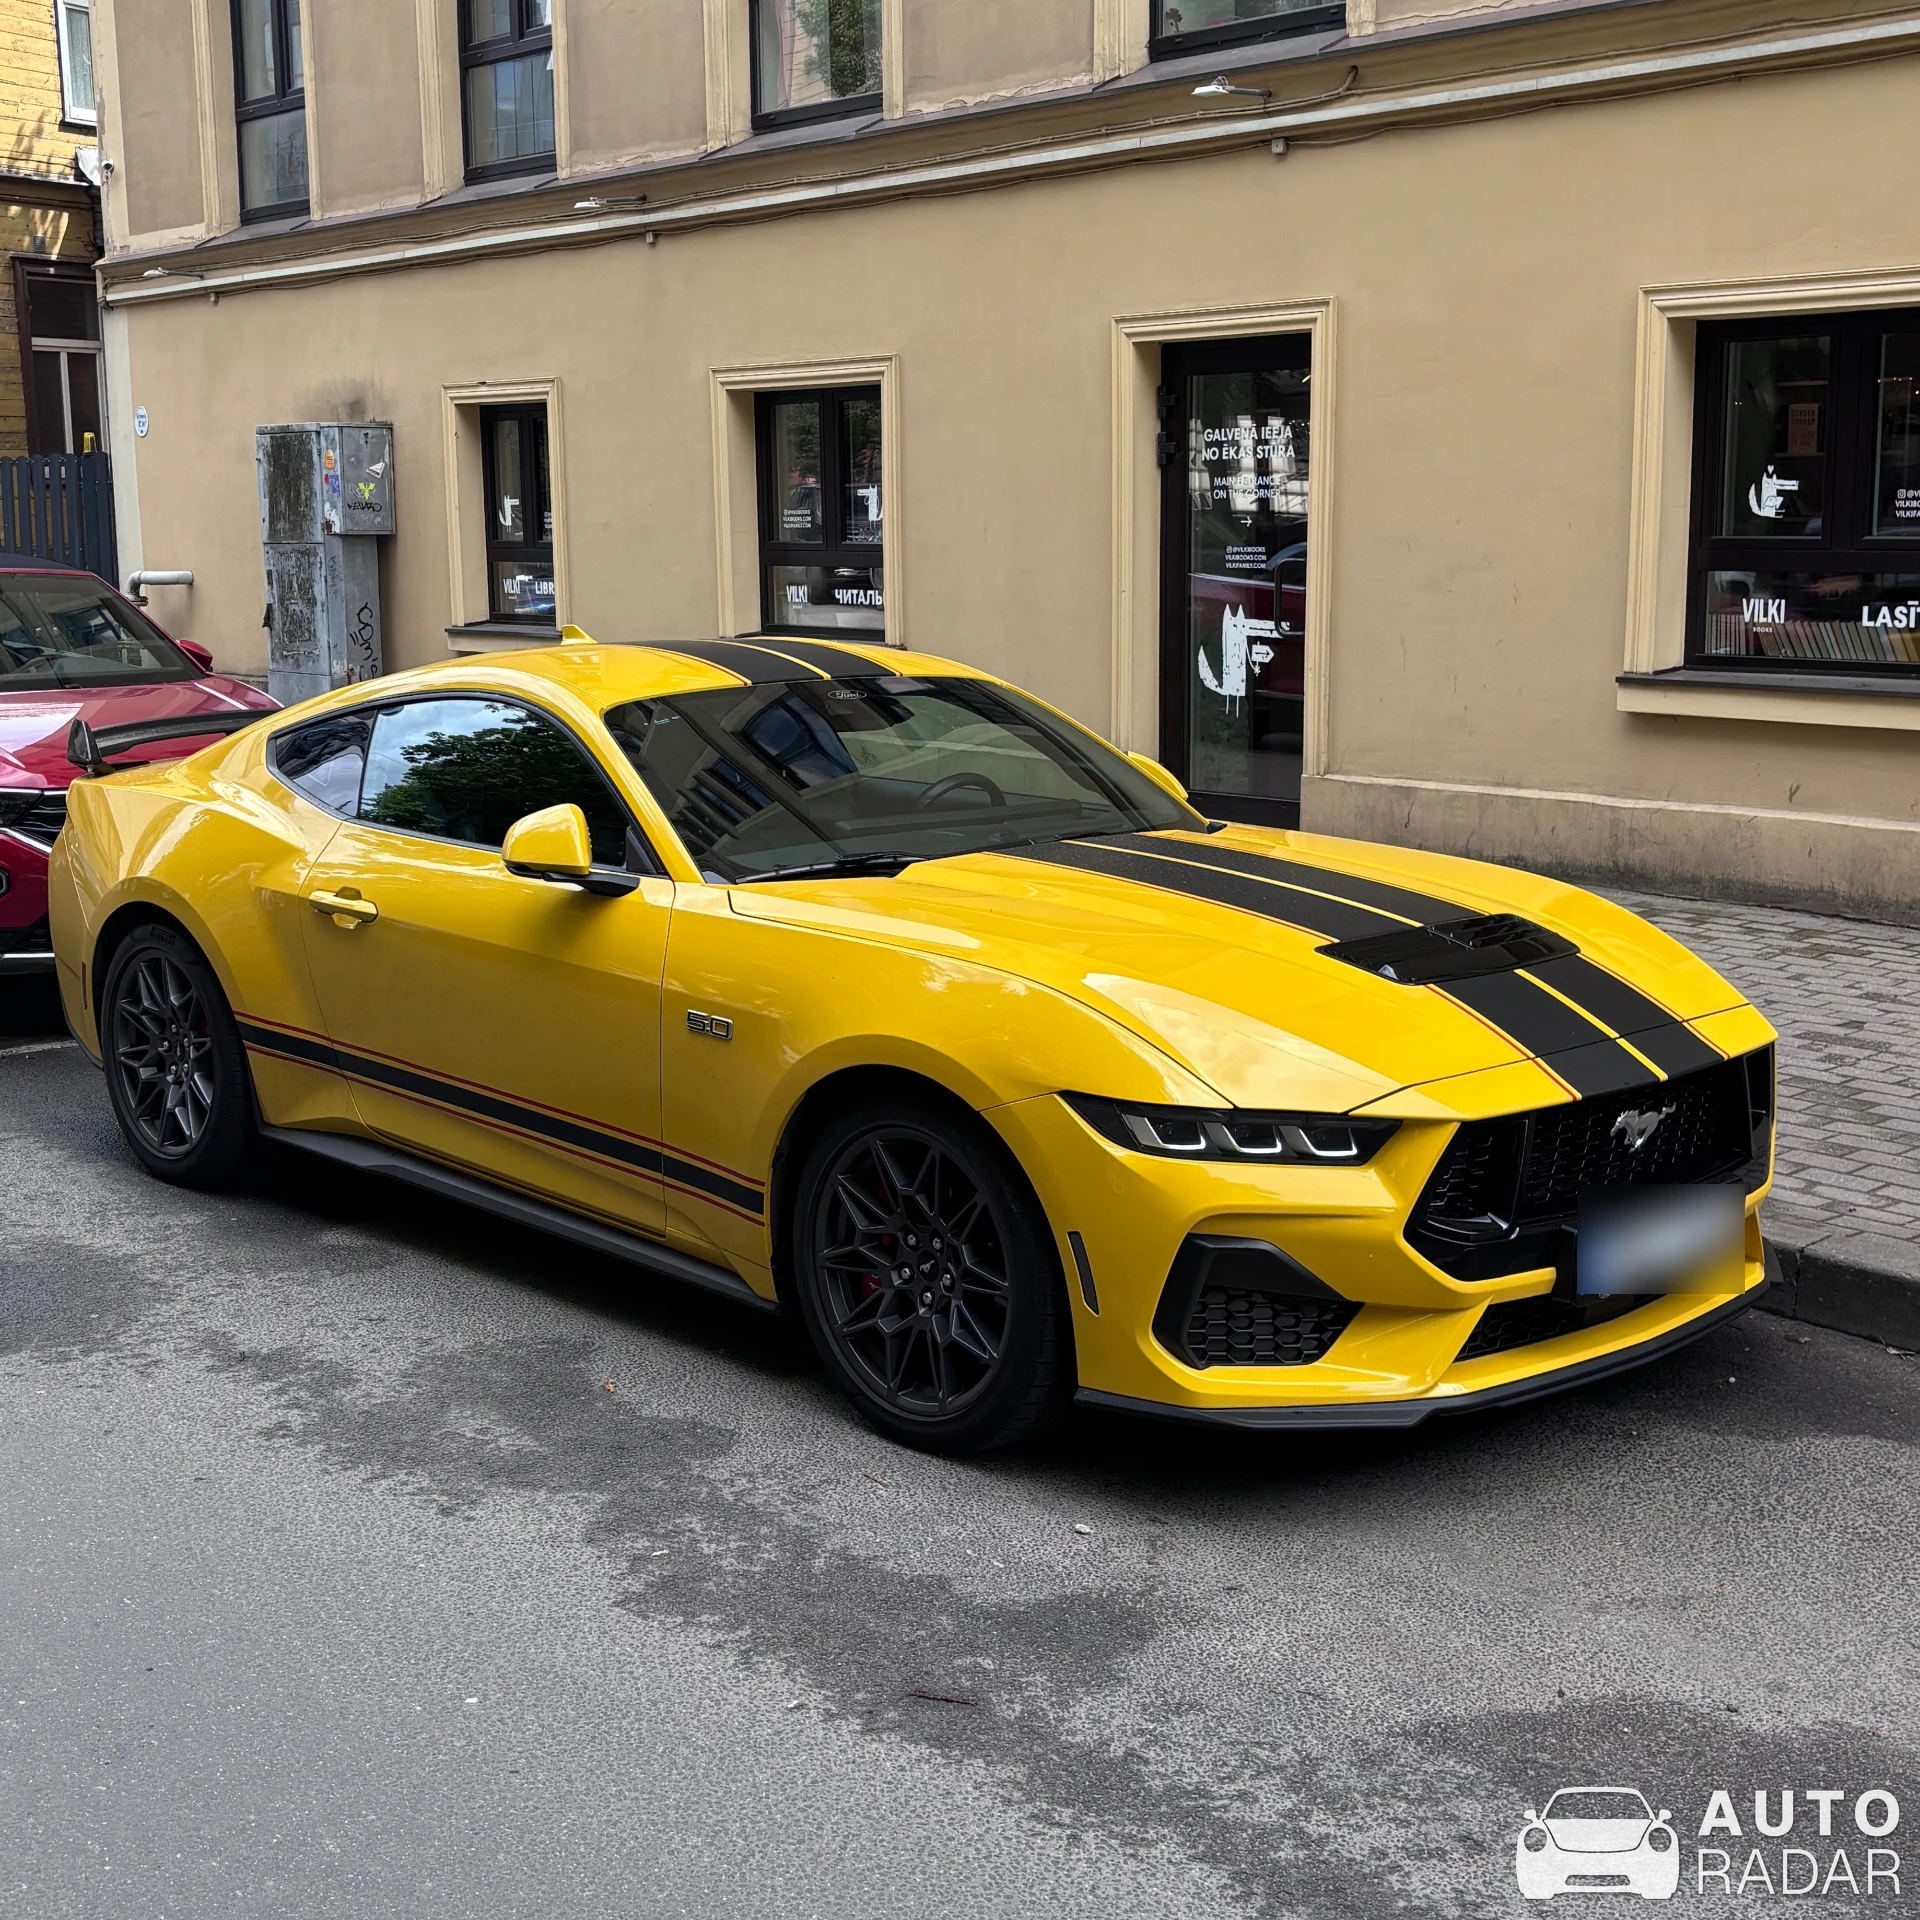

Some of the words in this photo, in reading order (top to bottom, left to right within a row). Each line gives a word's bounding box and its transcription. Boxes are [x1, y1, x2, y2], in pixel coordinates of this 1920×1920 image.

[1204, 424, 1258, 442] GALVENĀ
[1261, 425, 1293, 440] IEEJA
[1202, 447, 1219, 461] NO
[1222, 443, 1254, 460] ĒKAS
[1214, 477, 1234, 487] MAIN
[1213, 489, 1227, 499] ON
[1245, 488, 1281, 499] CORNER
[503, 578, 521, 594] VILKI
[786, 585, 808, 602] VILKI
[1743, 598, 1785, 624] VILKI
[1862, 601, 1920, 628] LASĪ
[686, 1009, 733, 1040] 5.0
